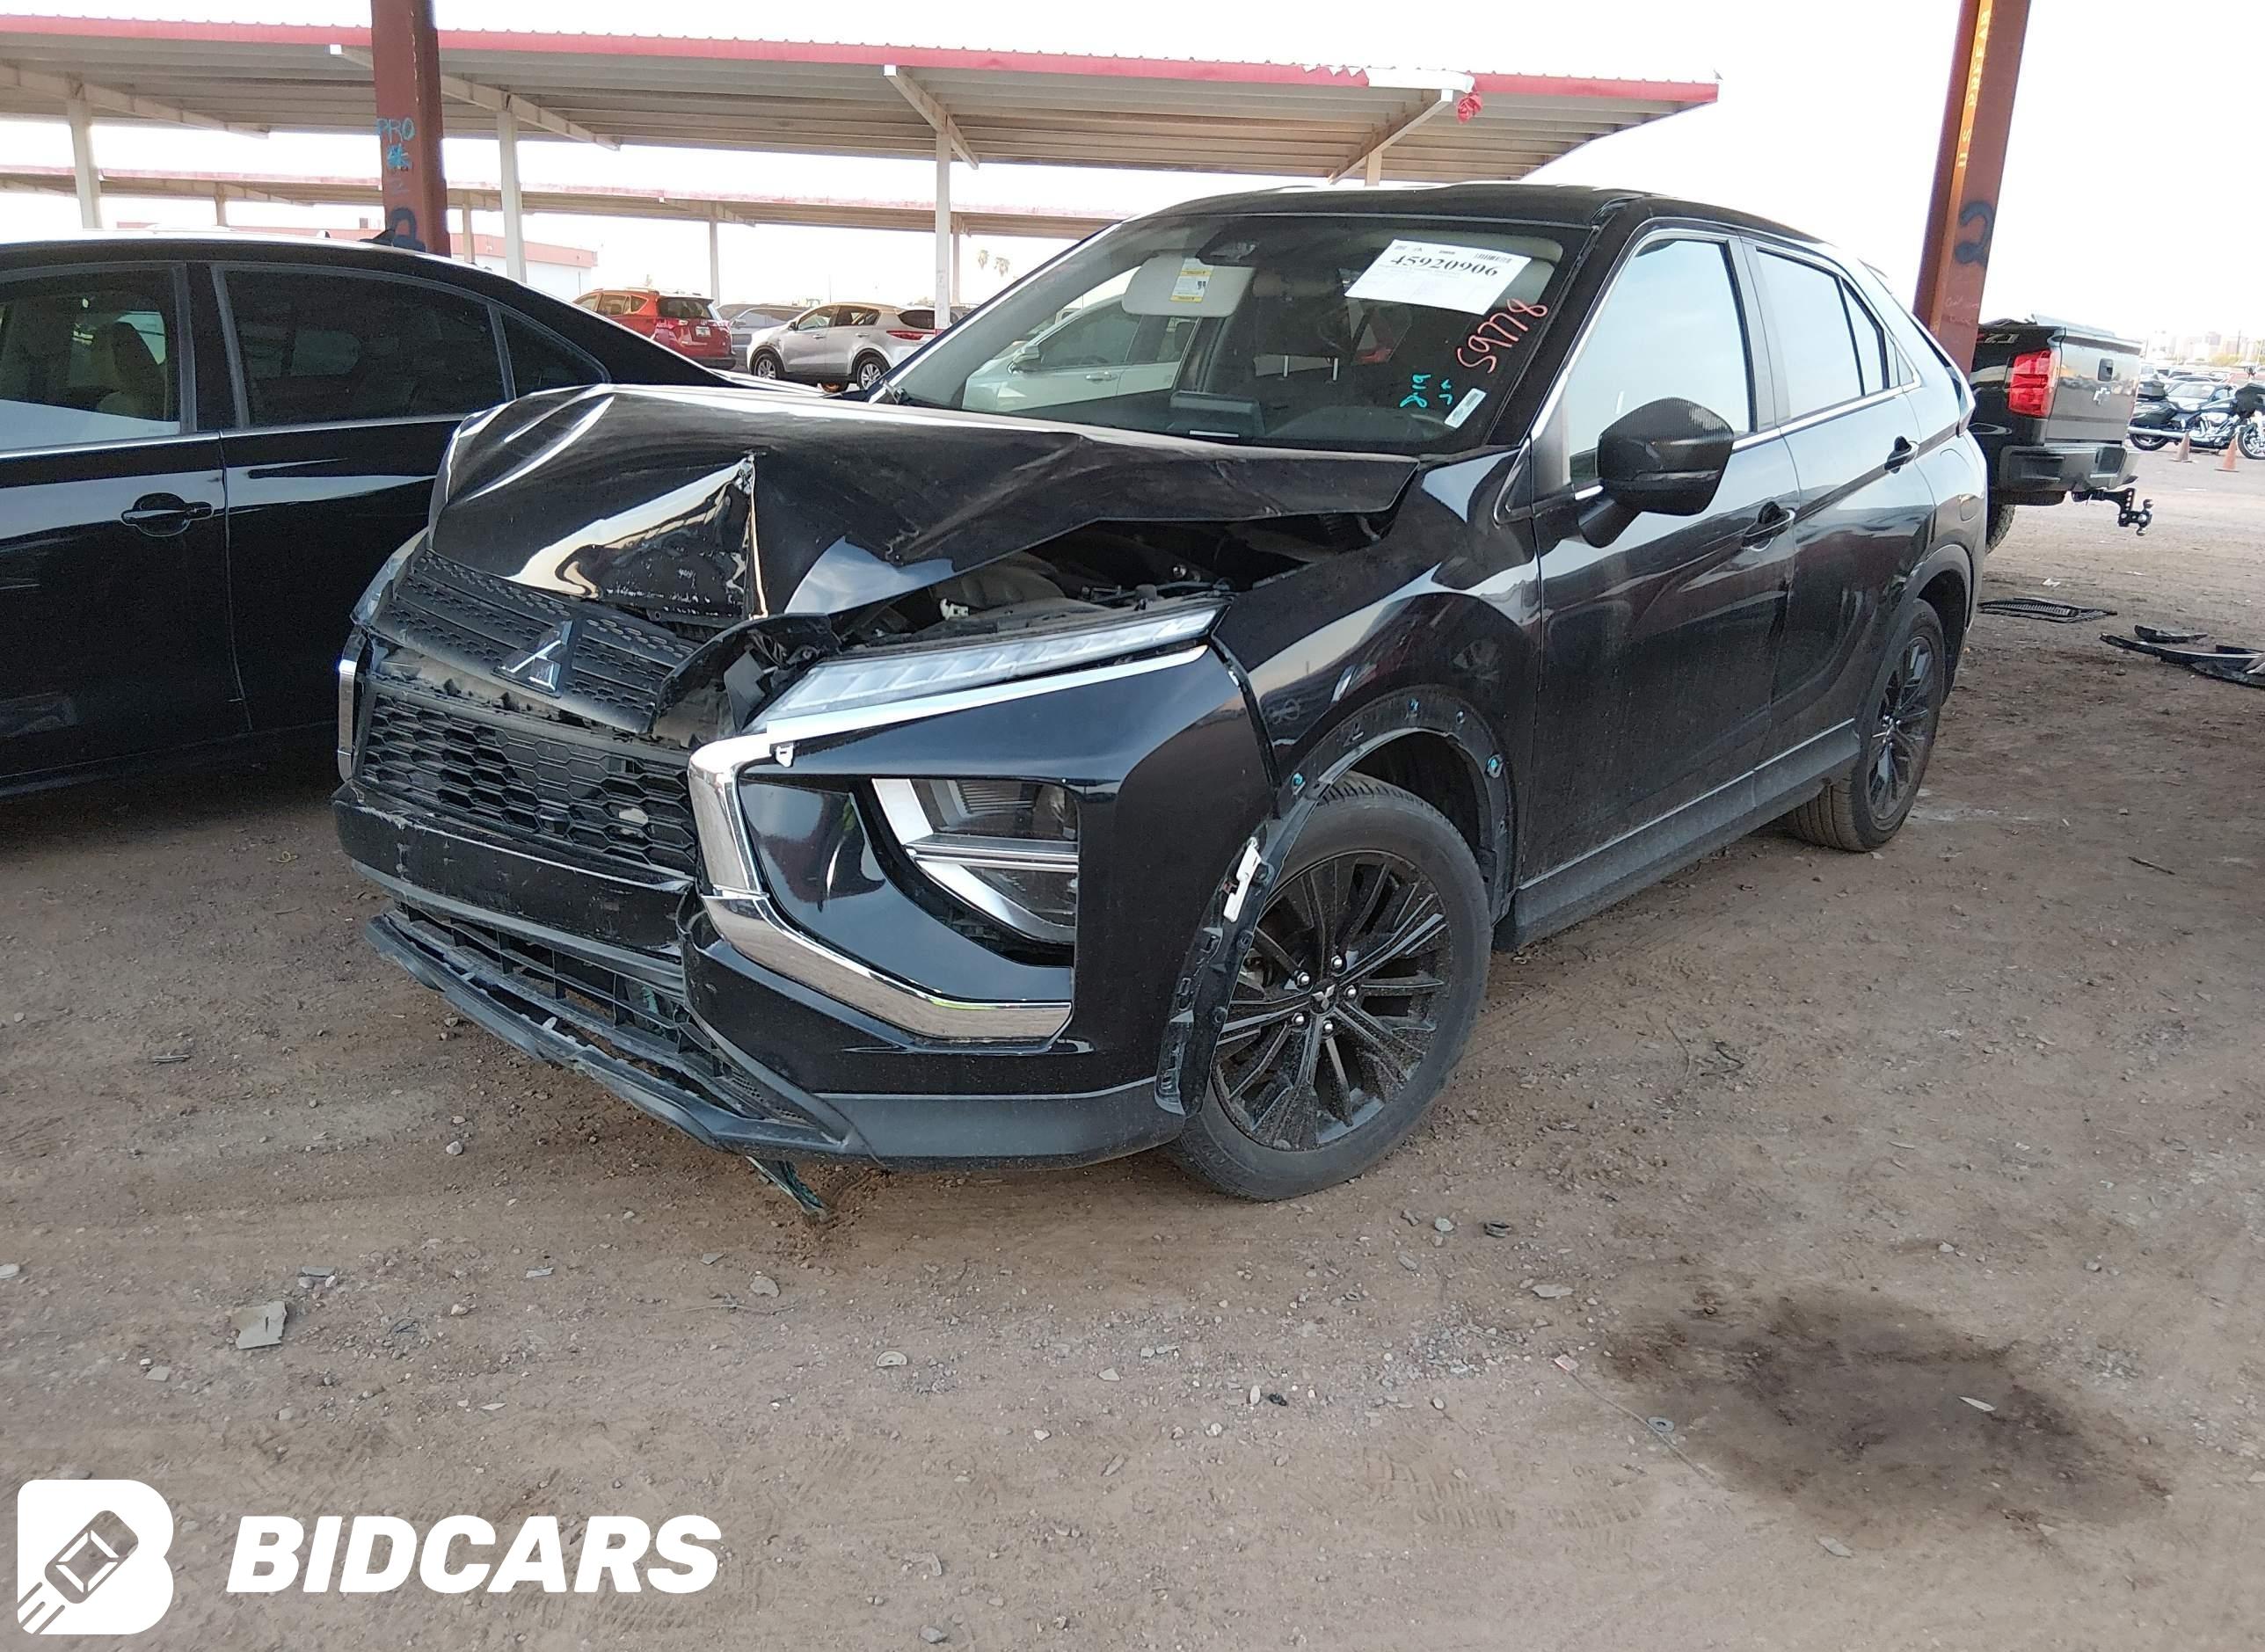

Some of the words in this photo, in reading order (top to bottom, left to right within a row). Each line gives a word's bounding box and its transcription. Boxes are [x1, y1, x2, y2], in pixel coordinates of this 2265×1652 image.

[1390, 254, 1498, 277] 45920906
[1955, 200, 1994, 268] 2
[1456, 298, 1548, 374] 59778
